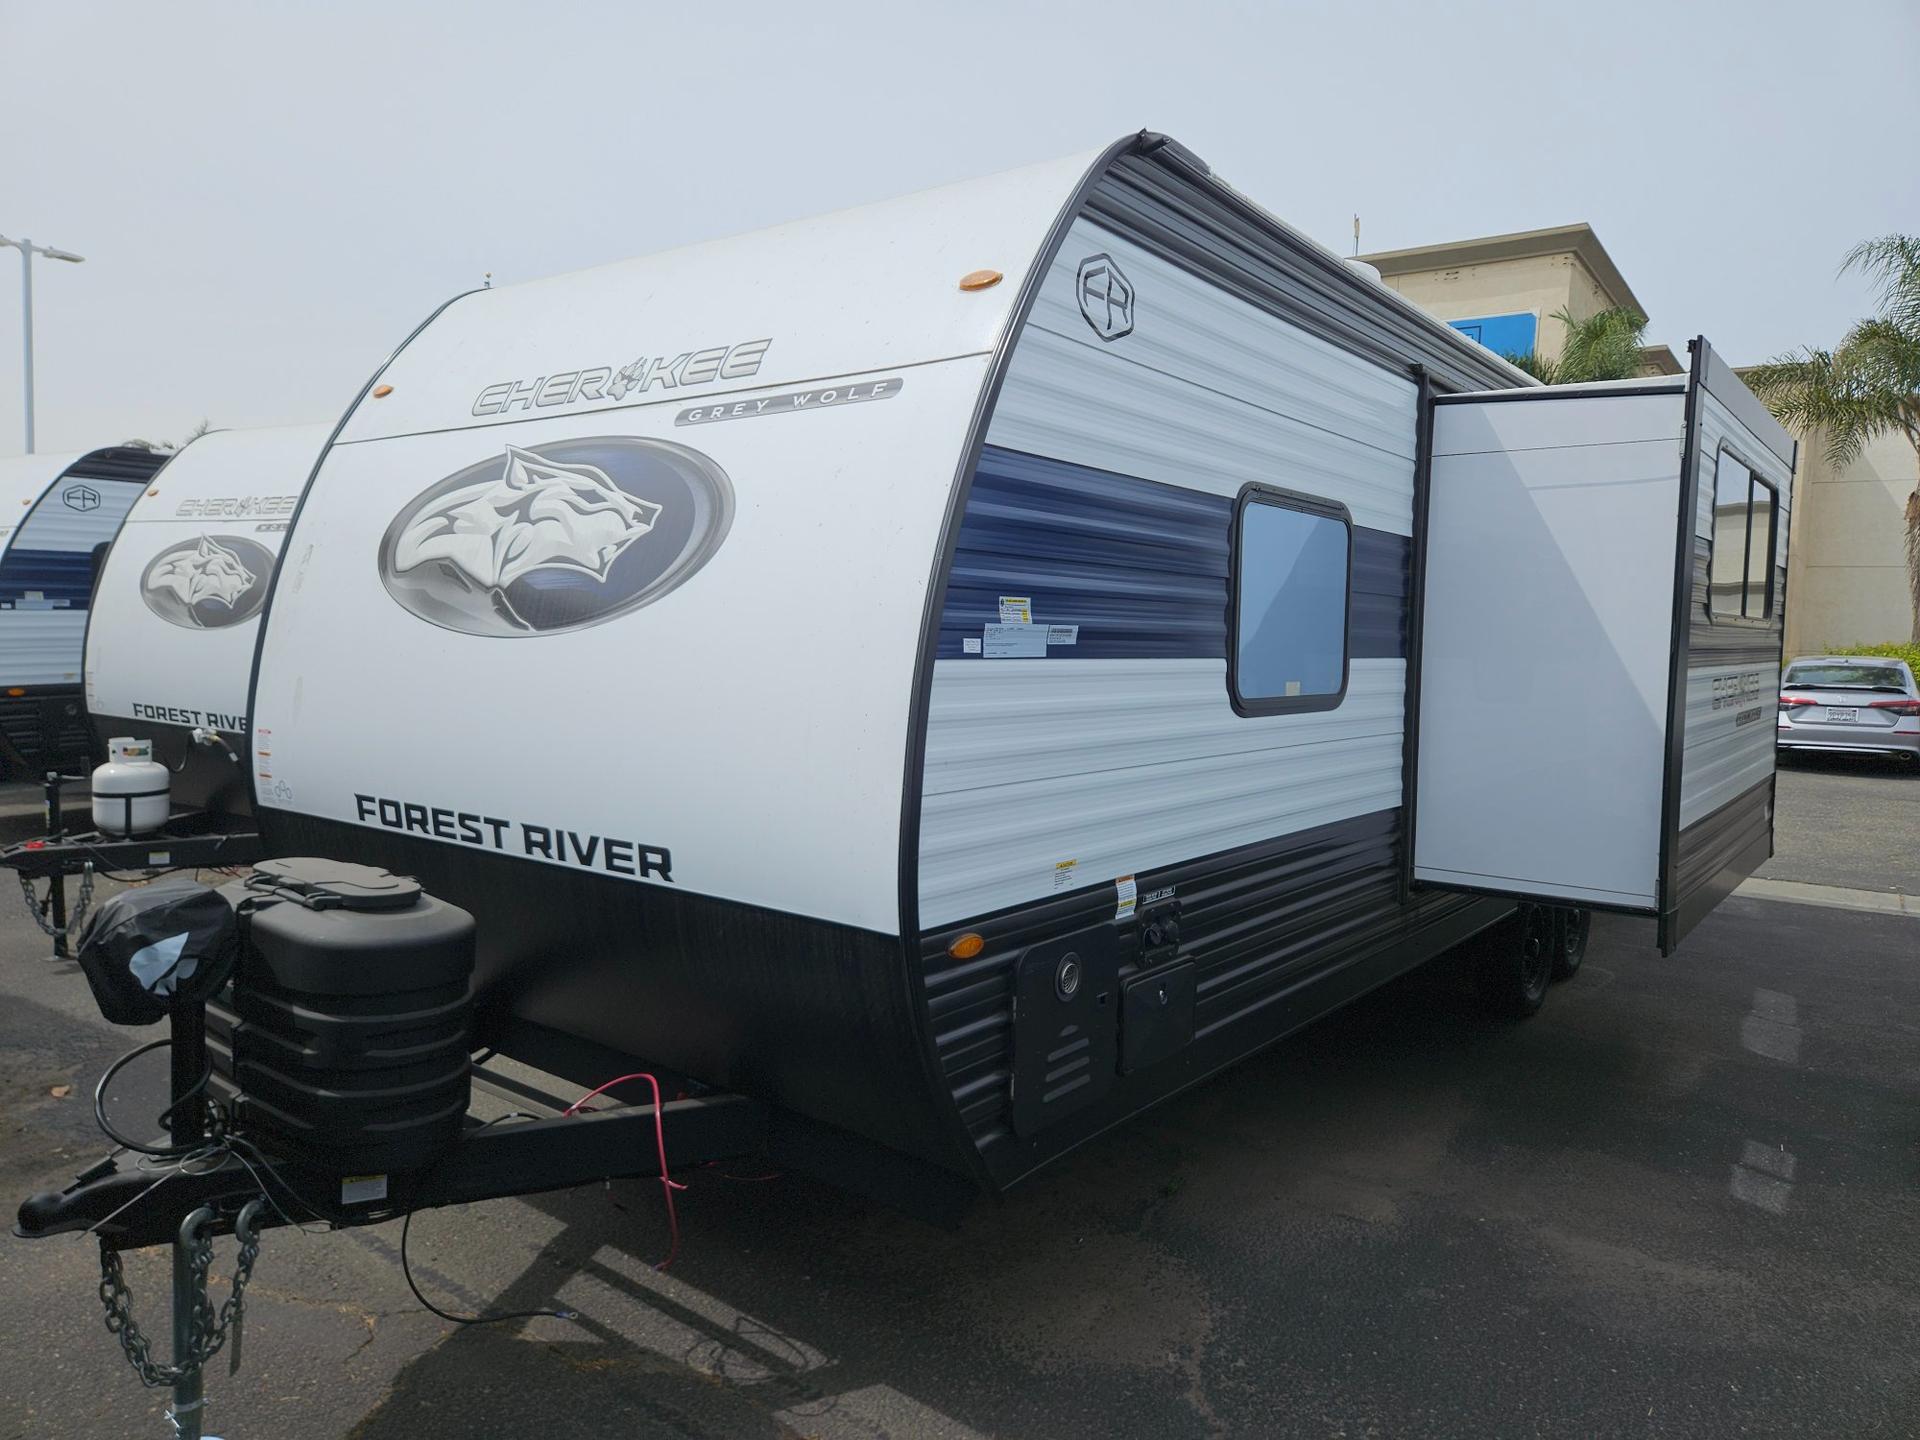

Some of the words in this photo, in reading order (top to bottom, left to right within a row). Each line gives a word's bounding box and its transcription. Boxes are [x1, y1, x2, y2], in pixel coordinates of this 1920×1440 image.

[688, 399, 770, 422] GREY
[793, 382, 888, 409] WOLF
[132, 702, 201, 725] FOREST
[354, 792, 510, 850] FOREST
[520, 822, 674, 883] RIVER
